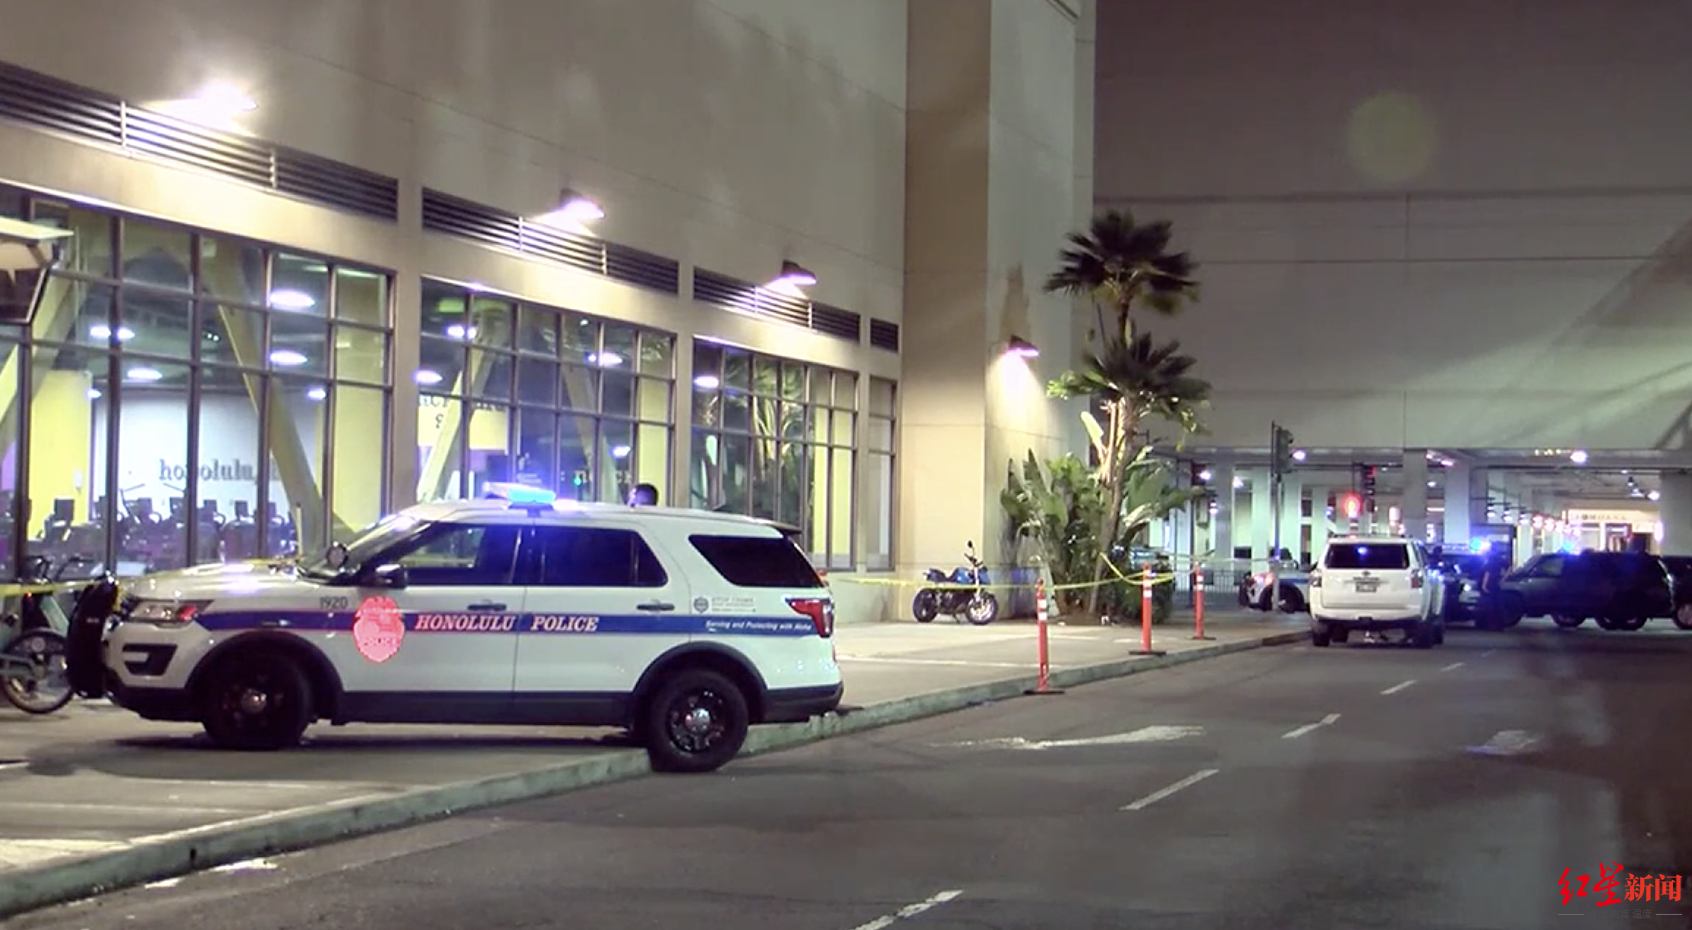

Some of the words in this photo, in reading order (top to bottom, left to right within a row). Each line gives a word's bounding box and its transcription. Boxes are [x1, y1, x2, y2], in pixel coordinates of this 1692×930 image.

[319, 597, 348, 609] 1920
[415, 614, 516, 631] HONOLULU
[530, 616, 599, 633] POLICE
[361, 637, 397, 648] POLICE
